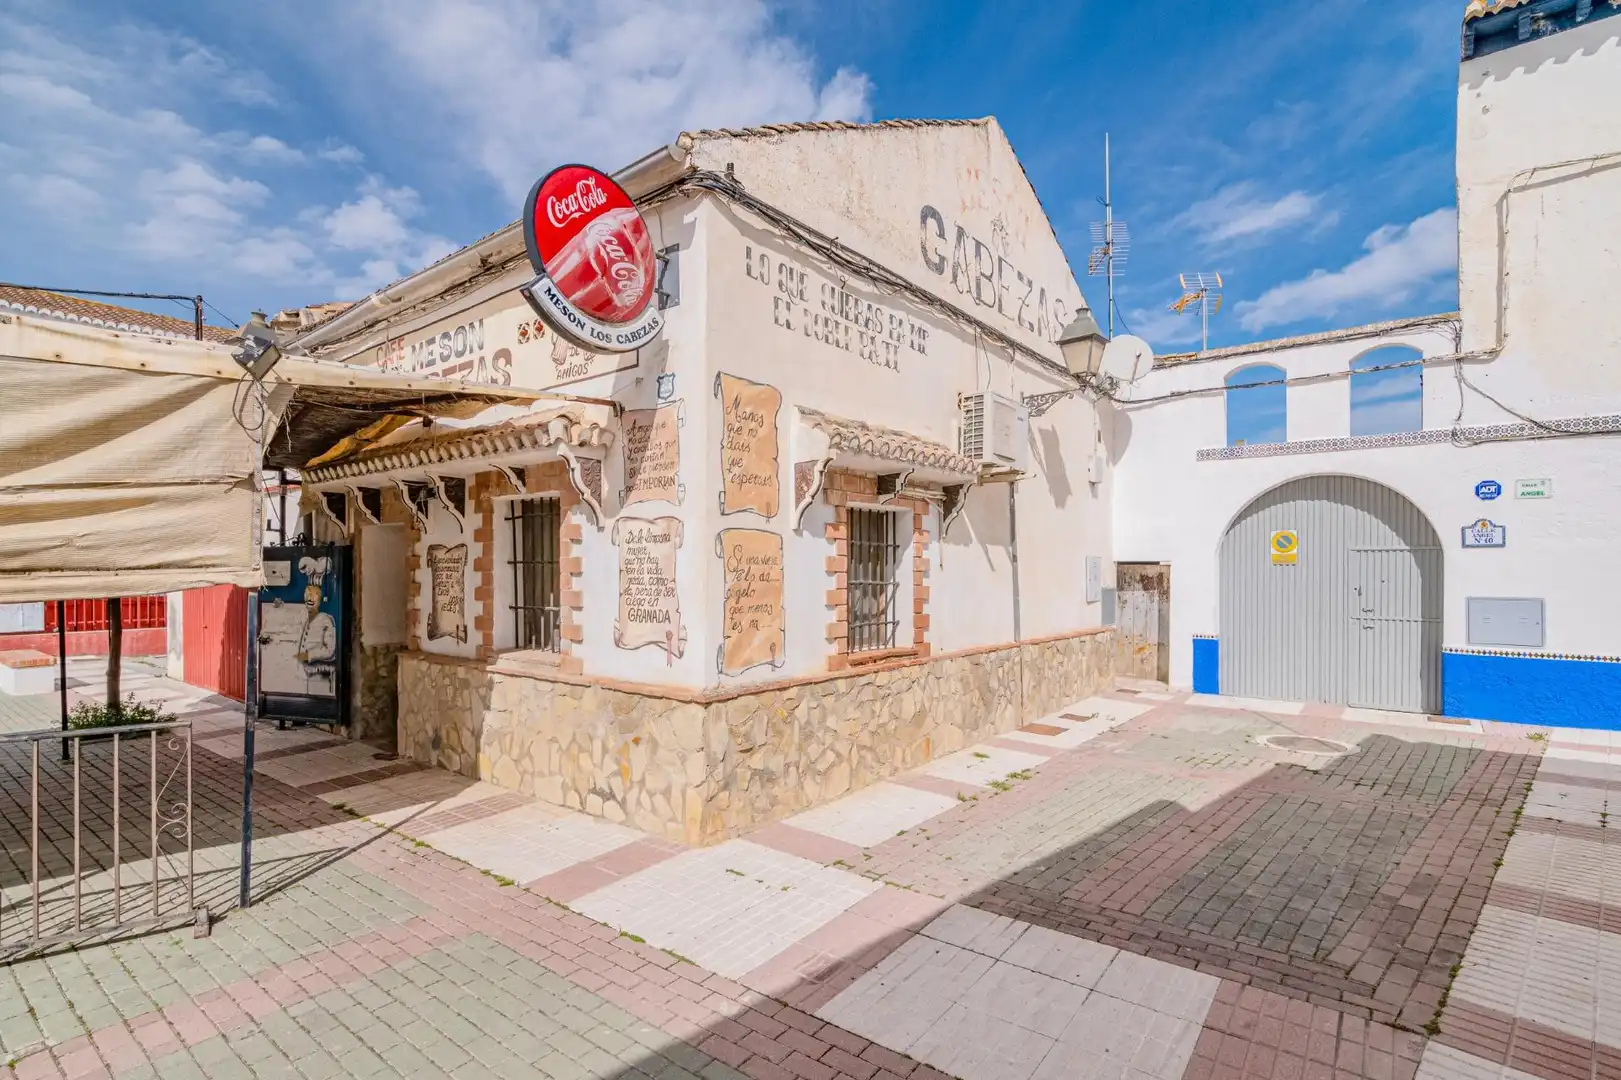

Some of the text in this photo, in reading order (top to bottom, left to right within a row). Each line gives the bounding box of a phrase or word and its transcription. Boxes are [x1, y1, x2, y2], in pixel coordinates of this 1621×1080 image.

[546, 175, 608, 228] Coca-Cola
[746, 245, 769, 285] LO
[778, 262, 809, 305] QUE
[821, 282, 883, 334] QUIERAS
[920, 203, 1068, 344] CABEZAS
[543, 286, 659, 345] MESON LOS CABEZAS
[773, 295, 796, 331] EL
[803, 307, 853, 353] DOBLE
[411, 319, 484, 372] MESON
[725, 394, 764, 428] Manos
[727, 423, 758, 439] que no
[726, 435, 751, 453] dais
[1480, 485, 1497, 493] ADT
[627, 607, 671, 624] GRANADA
